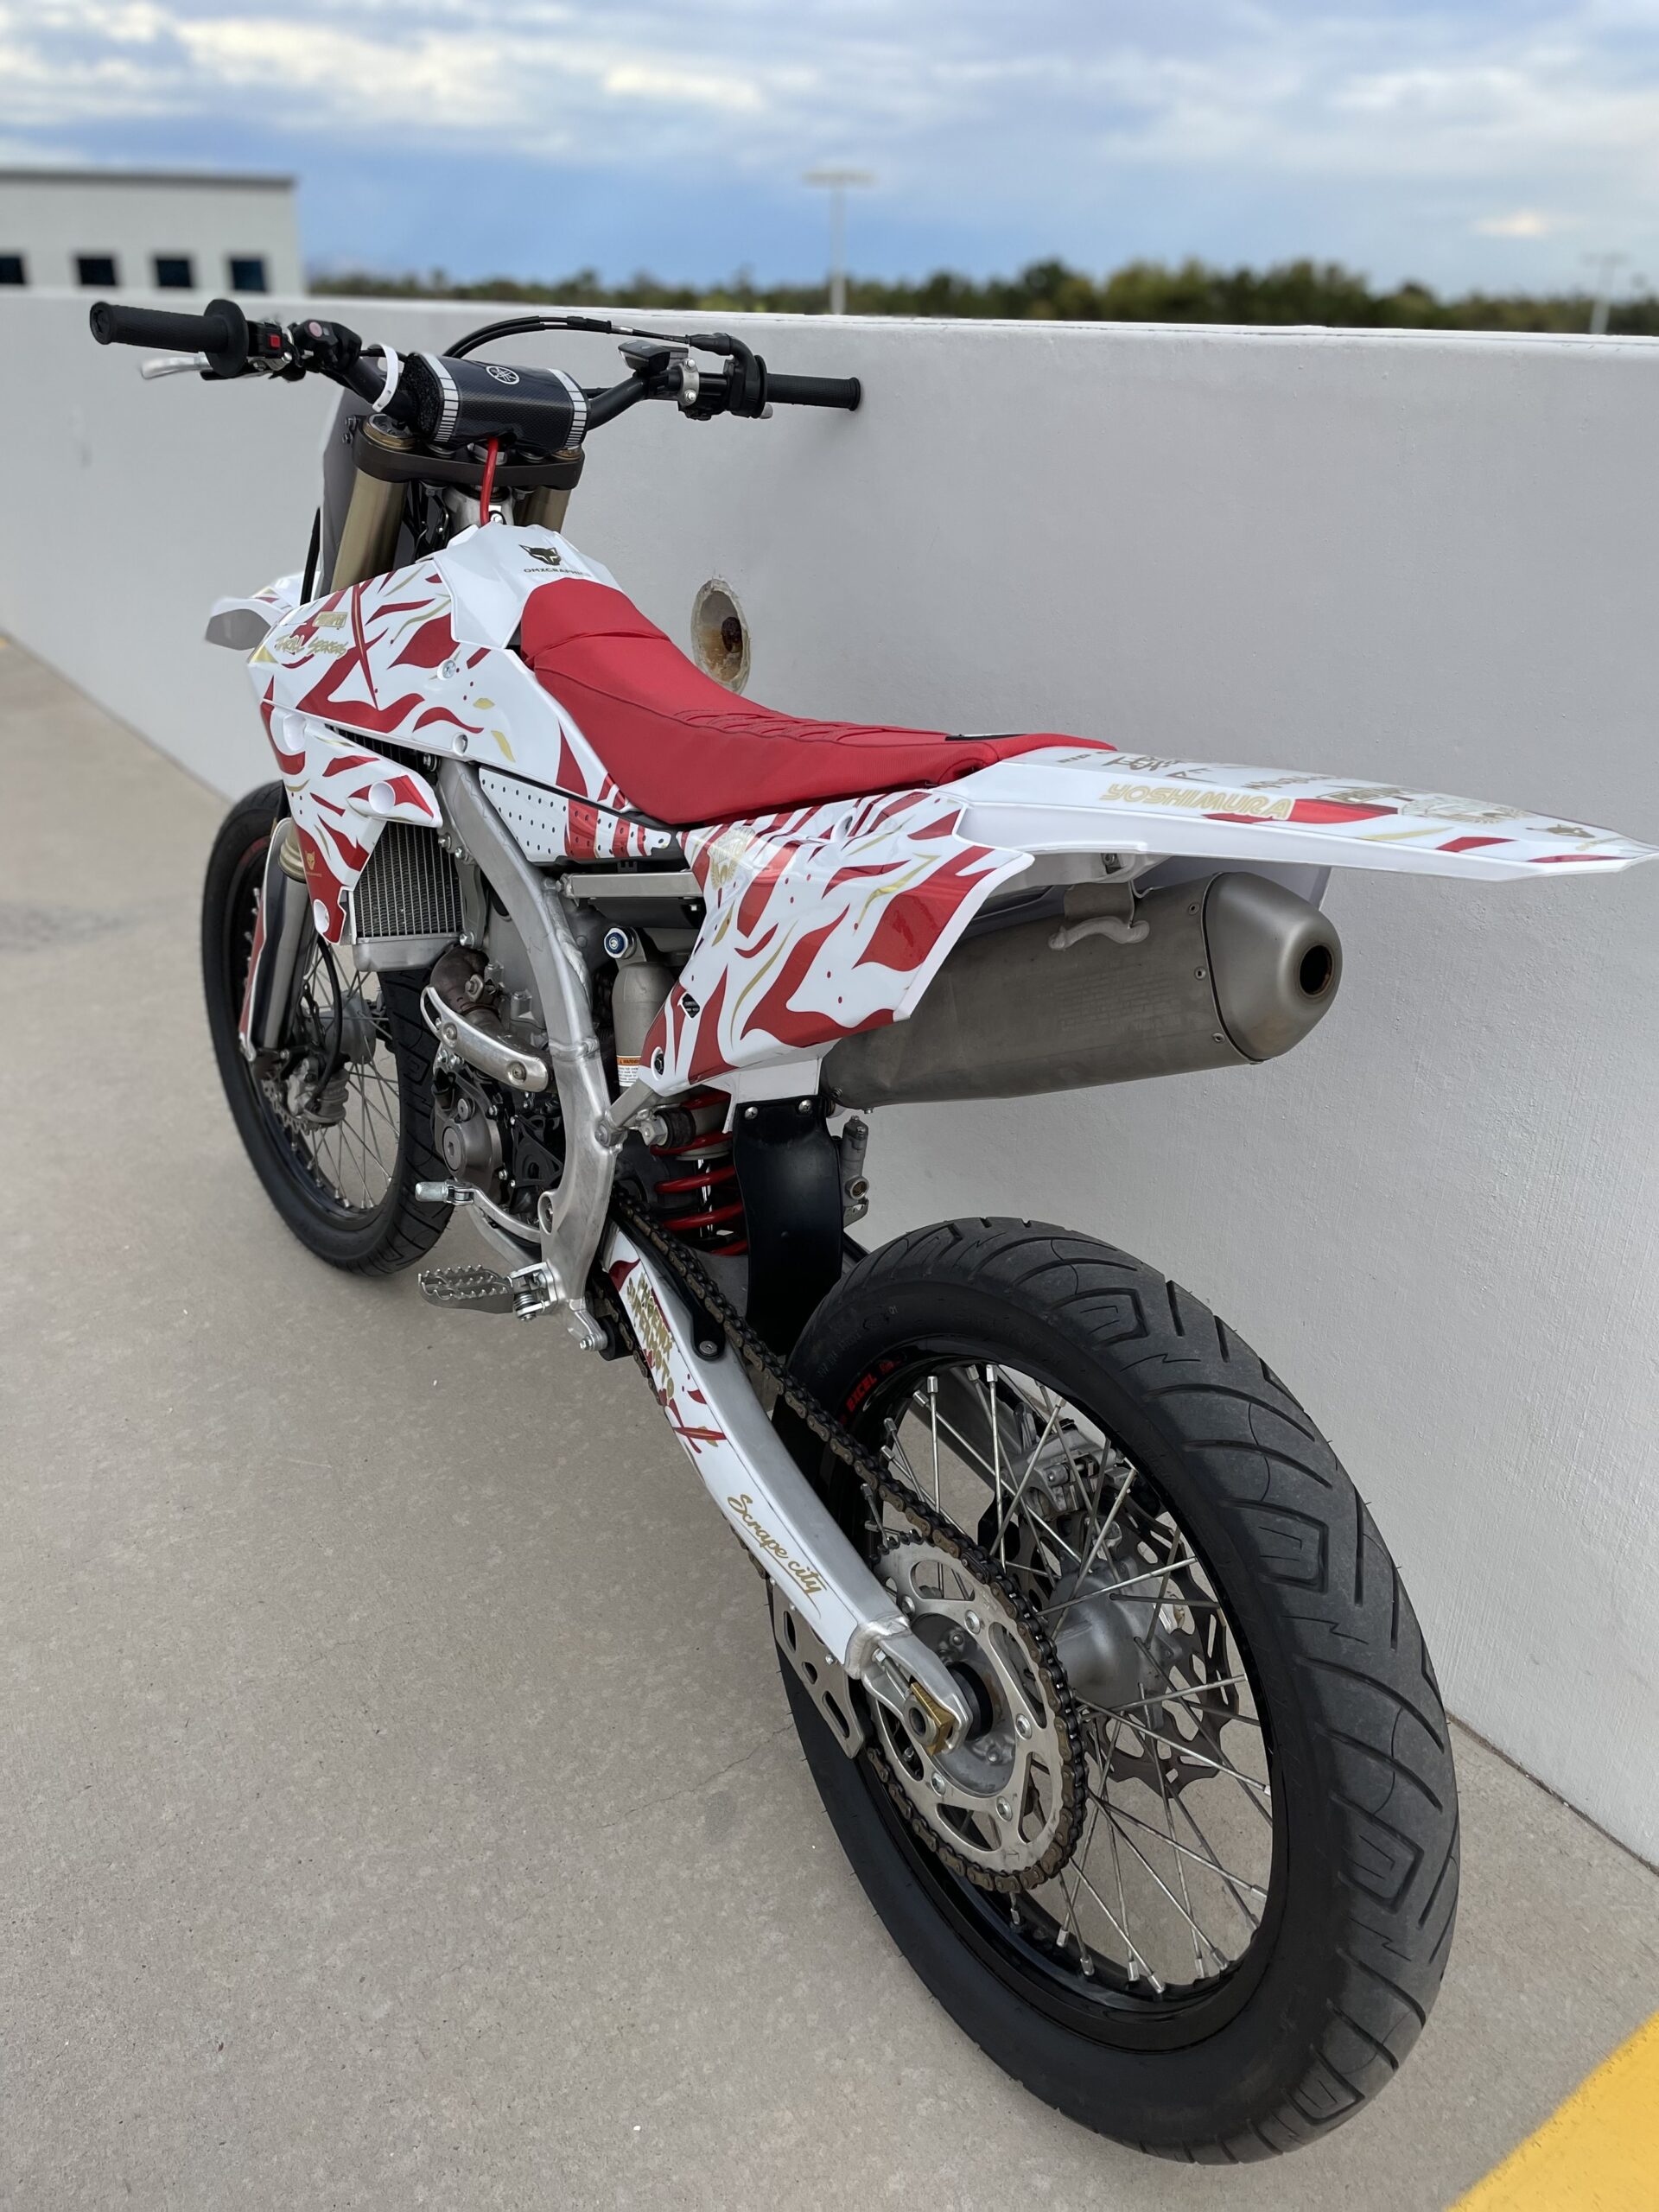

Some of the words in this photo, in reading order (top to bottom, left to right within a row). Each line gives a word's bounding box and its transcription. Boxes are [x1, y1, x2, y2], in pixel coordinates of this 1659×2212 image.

[1099, 783, 1292, 819] YOSHIMURA
[846, 1373, 877, 1412] EXCEL
[728, 1494, 789, 1559] Scrape
[787, 1560, 827, 1595] city
